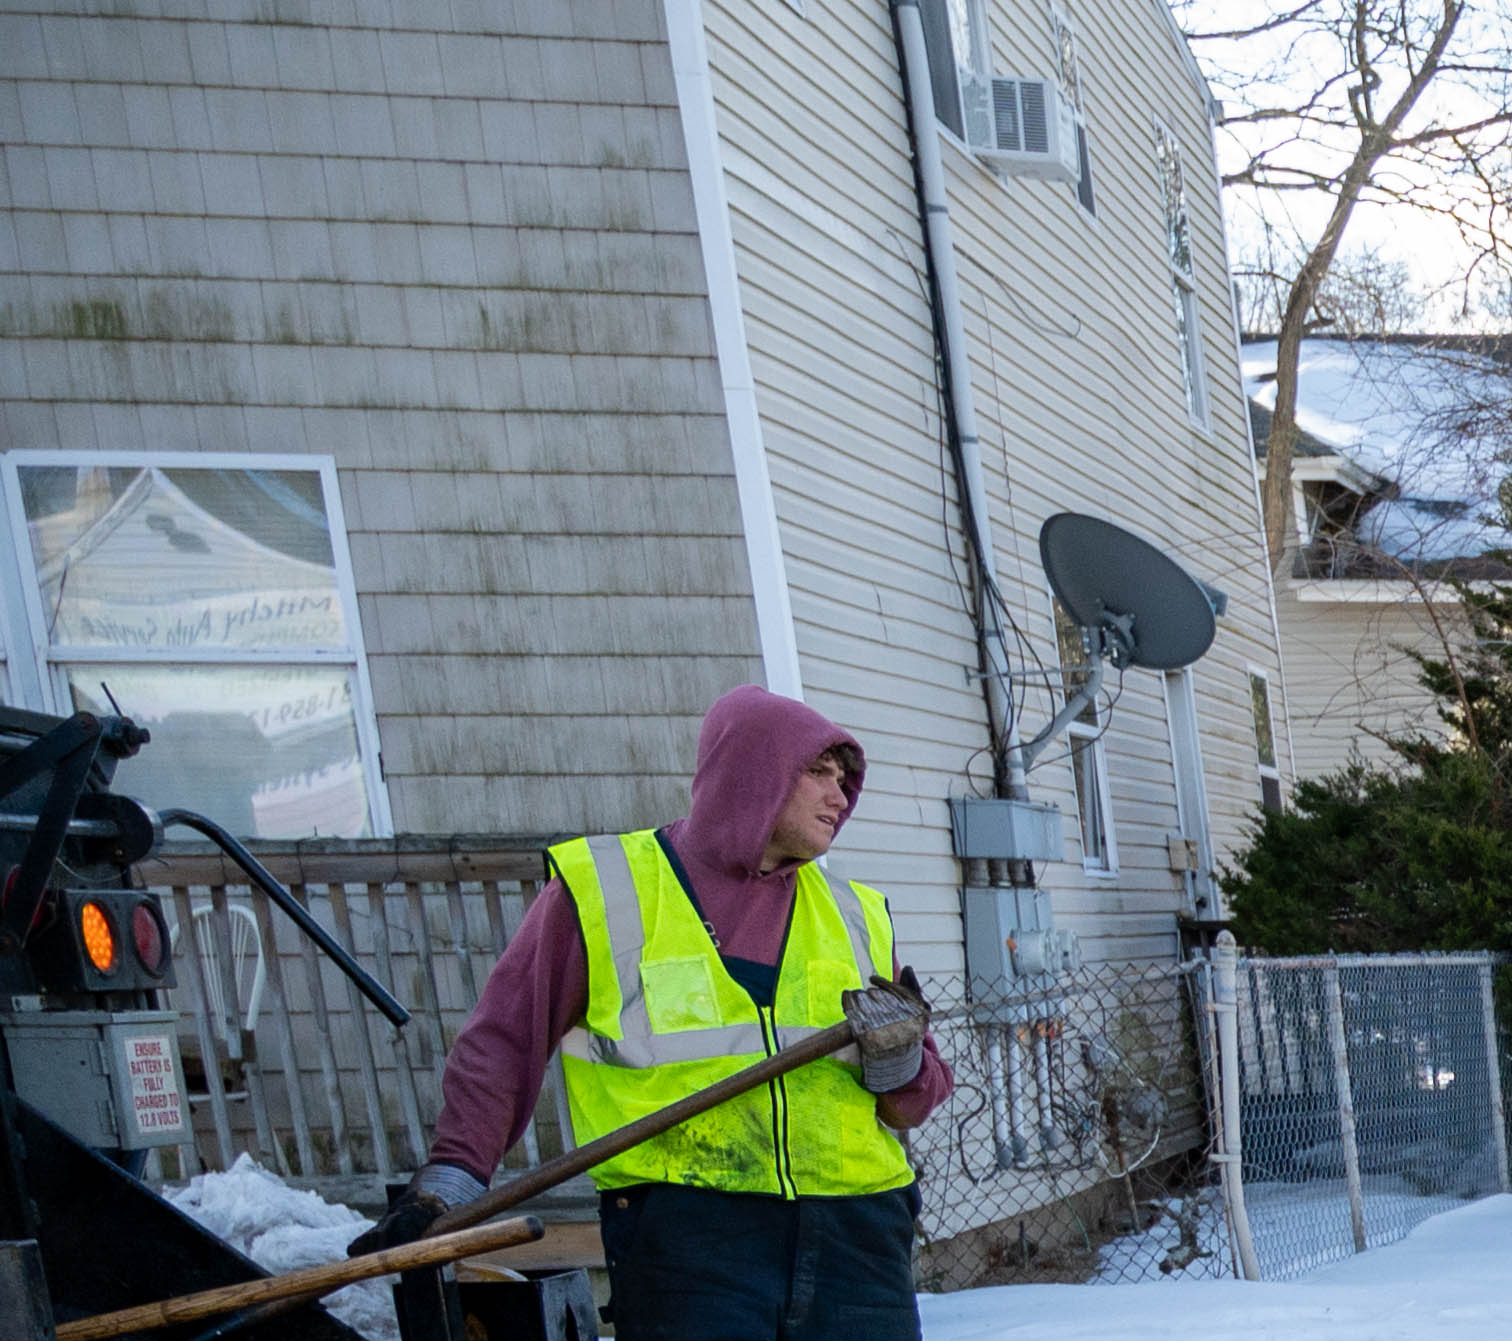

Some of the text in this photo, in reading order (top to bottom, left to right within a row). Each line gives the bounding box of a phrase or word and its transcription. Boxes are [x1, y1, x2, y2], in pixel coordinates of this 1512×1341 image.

[134, 1042, 162, 1057] ENSURE
[131, 1058, 171, 1075] BATTERY IS
[143, 1076, 164, 1092] FULLY
[135, 1092, 179, 1110] CHARGED TO
[157, 1110, 179, 1125] VOLTS
